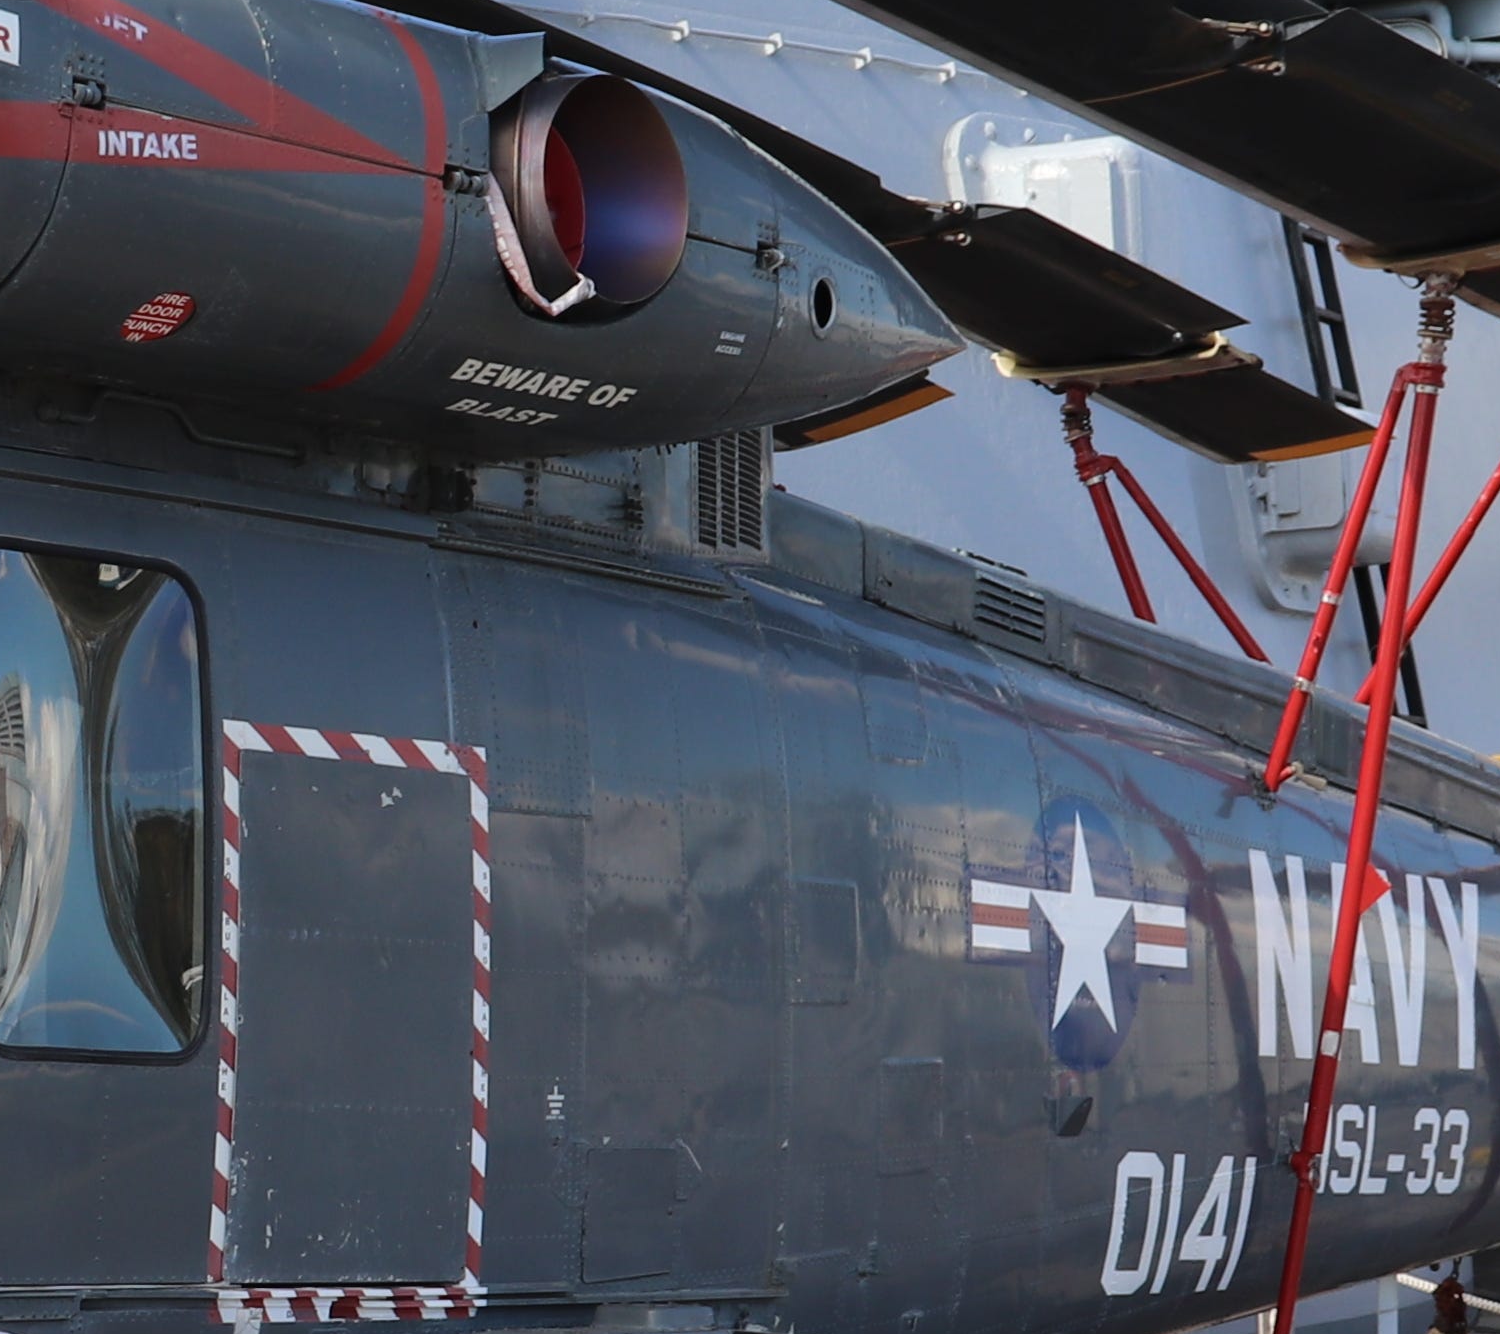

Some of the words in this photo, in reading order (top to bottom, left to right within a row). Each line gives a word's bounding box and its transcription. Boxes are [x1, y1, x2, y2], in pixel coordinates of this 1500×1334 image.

[99, 130, 198, 161] INTAKE
[138, 303, 184, 318] DOOR
[154, 292, 190, 306] FIRE
[125, 332, 145, 343] IN
[450, 358, 592, 403] BEWARE
[587, 384, 639, 410] OF
[446, 398, 558, 427] BLAST
[1248, 848, 1479, 1069] NAVY
[1101, 1150, 1257, 1296] 0141
